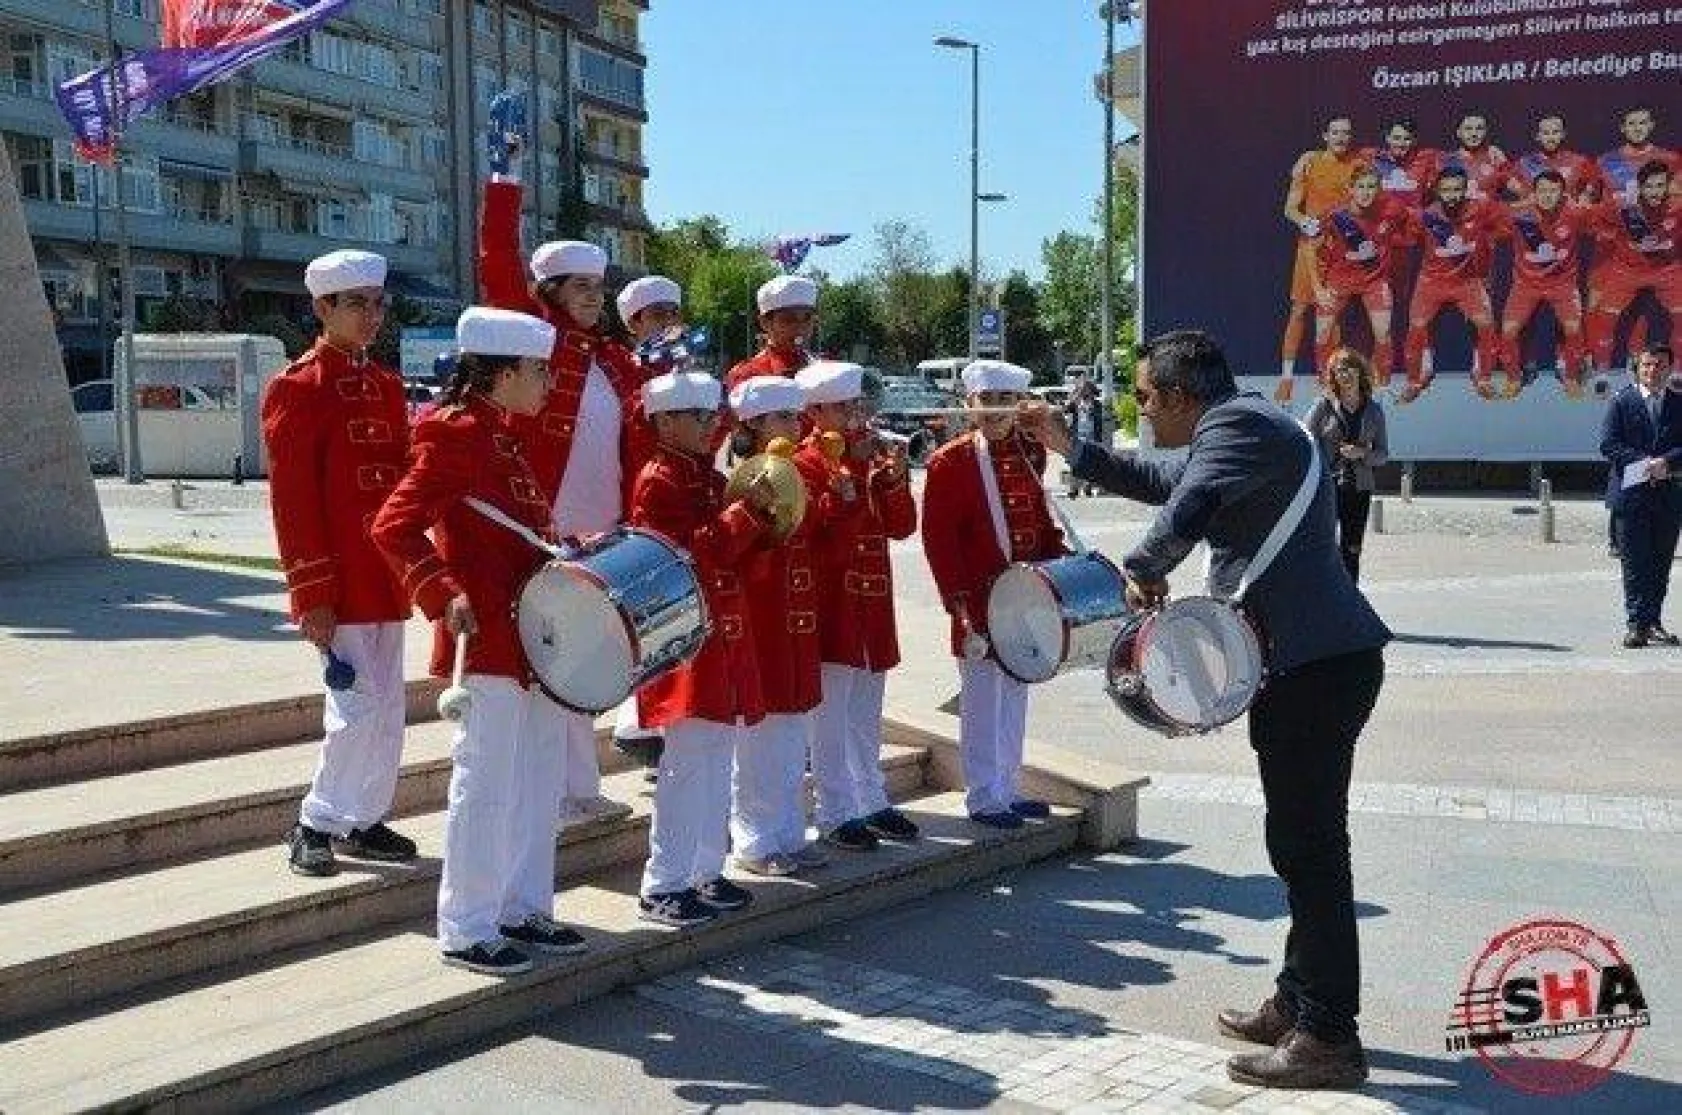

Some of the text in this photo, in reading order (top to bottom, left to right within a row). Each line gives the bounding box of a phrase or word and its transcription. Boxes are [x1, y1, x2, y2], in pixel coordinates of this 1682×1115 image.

[1388, 2, 1446, 22] Futbol
[1247, 40, 1279, 57] yaz
[1282, 37, 1307, 54] kış
[1311, 29, 1394, 50] desteğini
[1398, 23, 1520, 45] esirgemeyen
[1523, 13, 1582, 35] Silivri
[1374, 66, 1439, 88] Özcan
[1445, 60, 1527, 88] IŞIKLAR
[1531, 61, 1540, 78] /
[1544, 53, 1643, 78] Belediye
